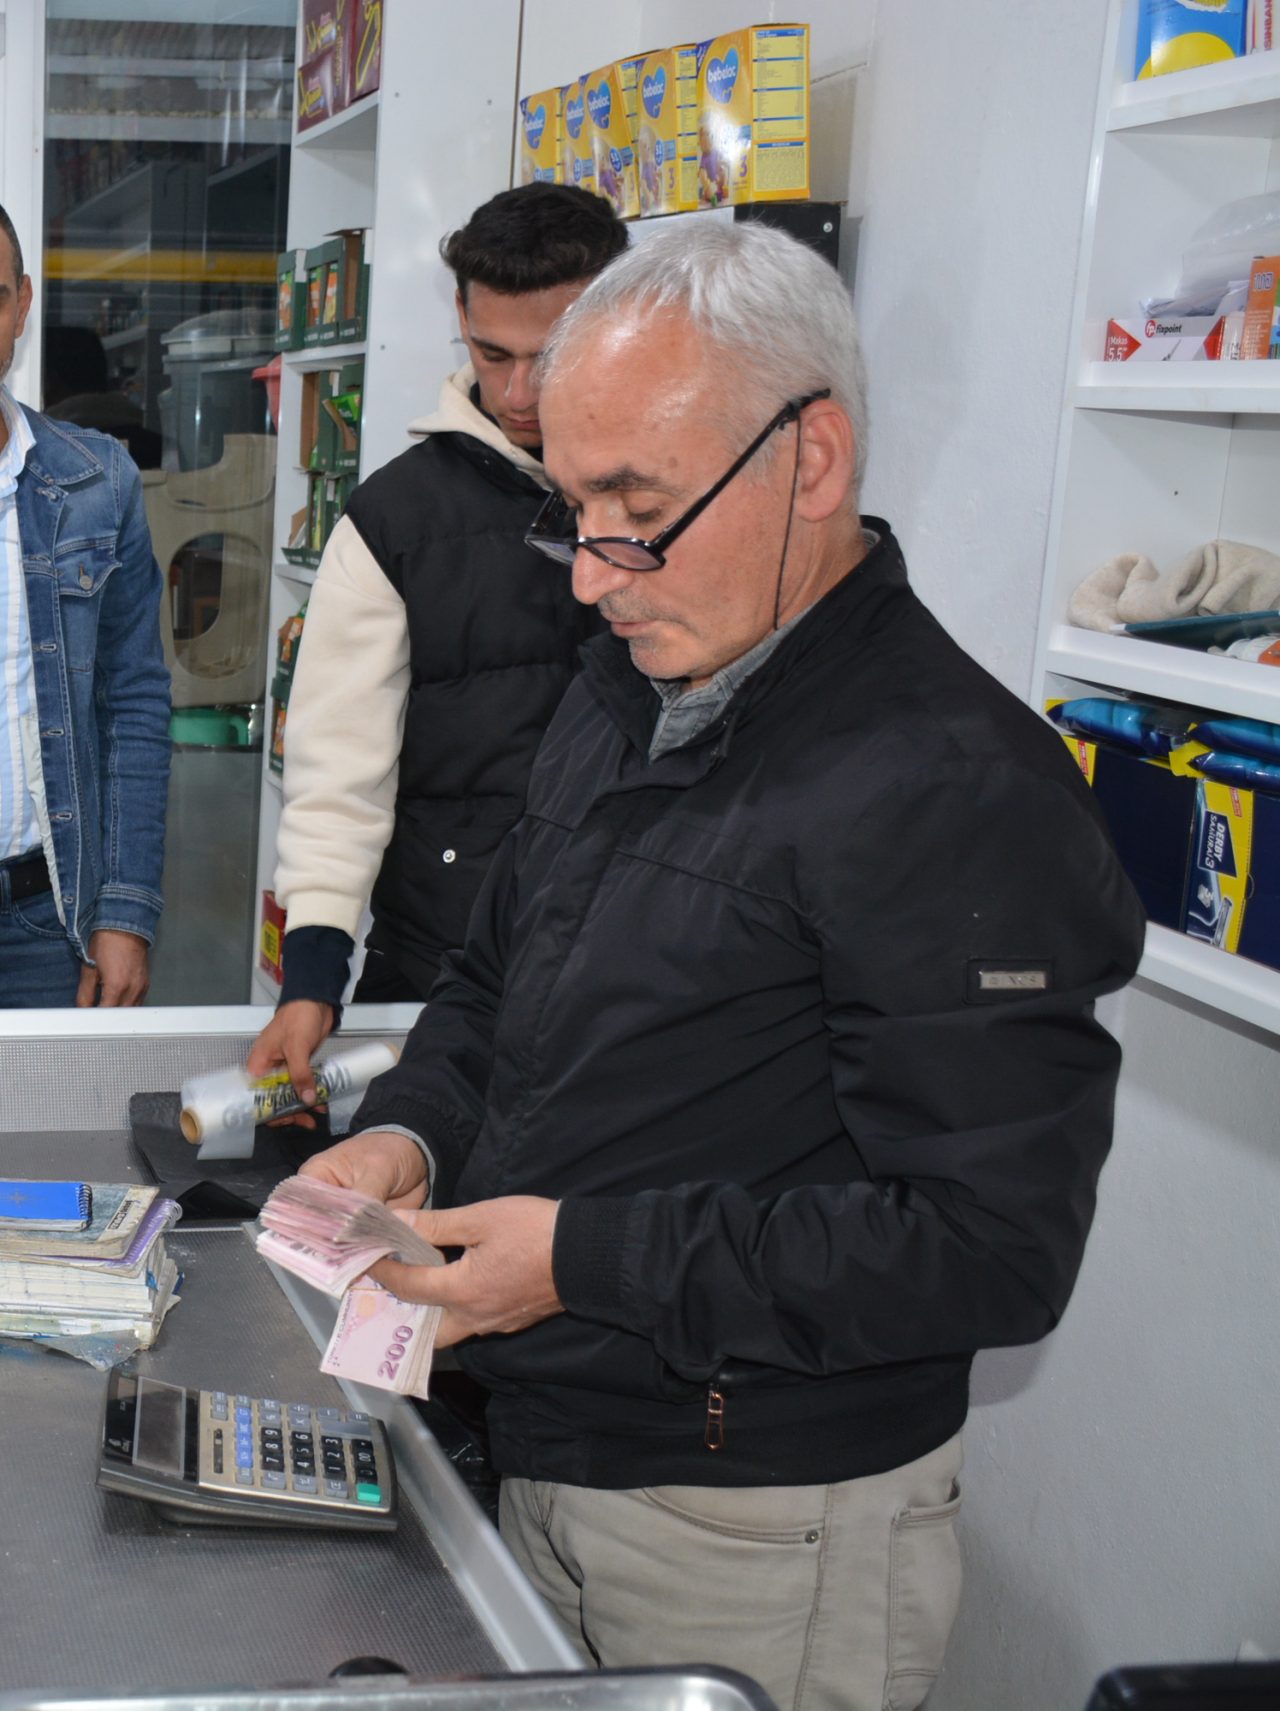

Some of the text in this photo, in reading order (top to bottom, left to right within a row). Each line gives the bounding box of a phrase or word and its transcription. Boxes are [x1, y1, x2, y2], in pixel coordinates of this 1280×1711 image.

[707, 65, 737, 83] bebelac
[643, 81, 664, 99] bebelac
[588, 94, 610, 112] bebelac
[738, 154, 748, 177] 3
[667, 167, 676, 190] 3
[1156, 323, 1183, 336] fixpoint
[1109, 335, 1129, 345] Makas
[1206, 813, 1218, 860] SAMURAI
[1213, 822, 1227, 863] DERBY
[1204, 857, 1216, 870] 3
[377, 1325, 414, 1380] 200
